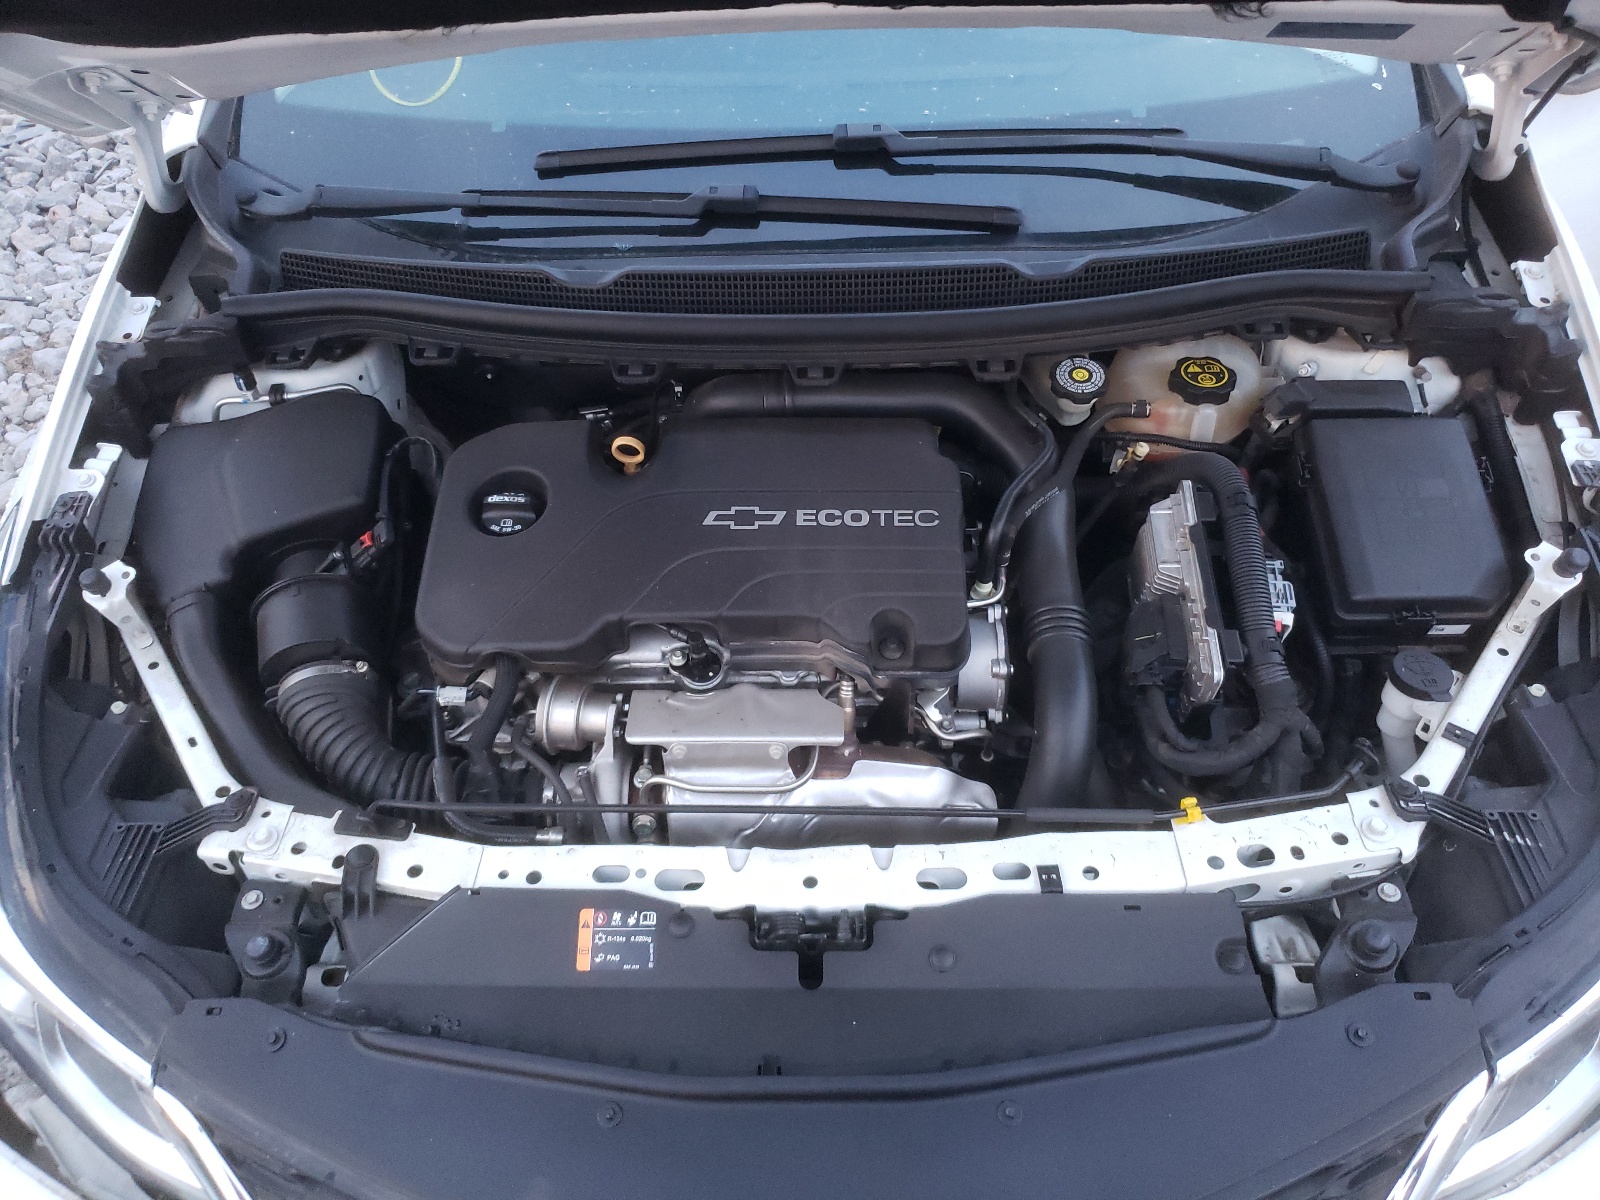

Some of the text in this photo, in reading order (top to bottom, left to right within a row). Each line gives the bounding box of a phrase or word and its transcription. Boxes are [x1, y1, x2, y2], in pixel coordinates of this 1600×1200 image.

[487, 494, 526, 503] dexos
[795, 509, 940, 527] ECOTEC
[606, 953, 620, 961] PAG
